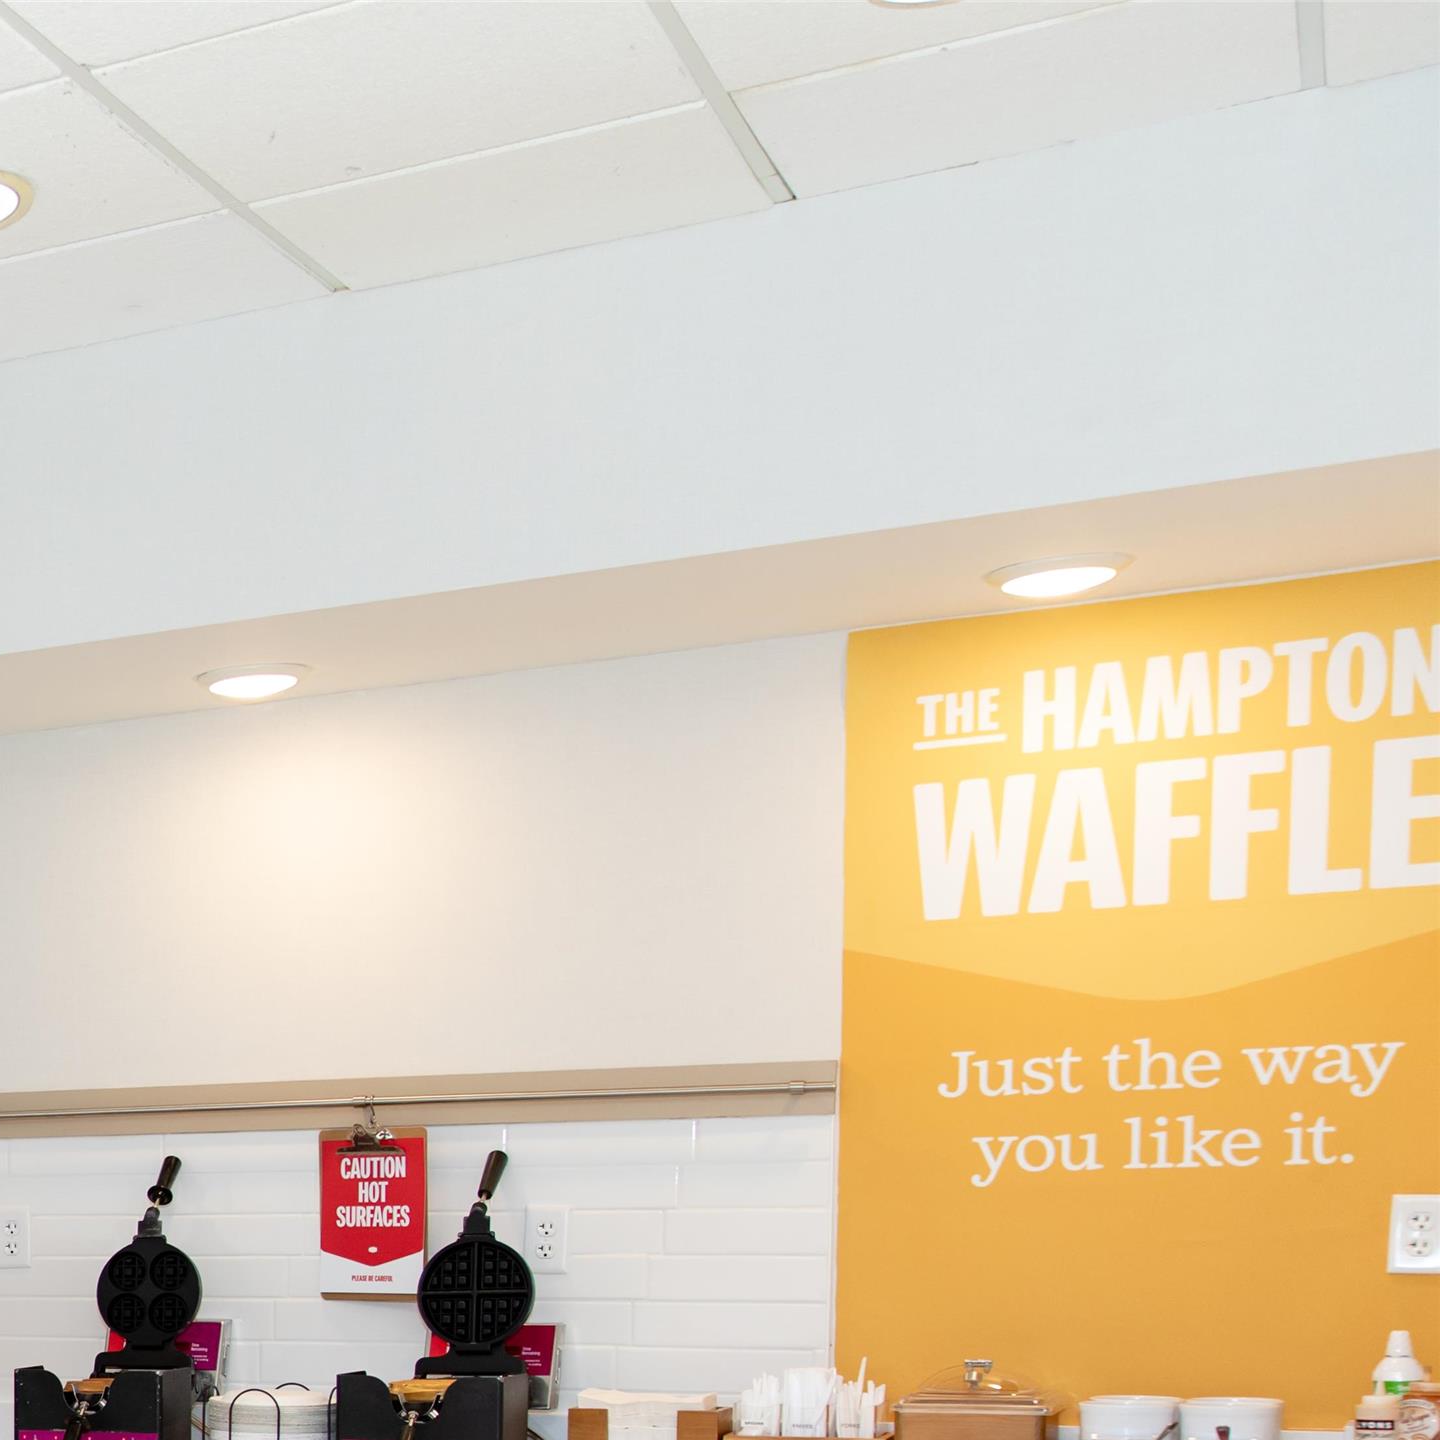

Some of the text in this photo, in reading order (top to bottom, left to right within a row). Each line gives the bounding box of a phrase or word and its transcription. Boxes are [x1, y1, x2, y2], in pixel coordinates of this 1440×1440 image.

[916, 624, 1440, 753] THE HAMPTON
[914, 735, 1440, 921] WAFFLE
[937, 1038, 1406, 1098] Just the way
[340, 1156, 407, 1180] CAUTION
[970, 1111, 1355, 1188] you like it.
[336, 1204, 410, 1228] SURFACES
[358, 1181, 388, 1203] HOT
